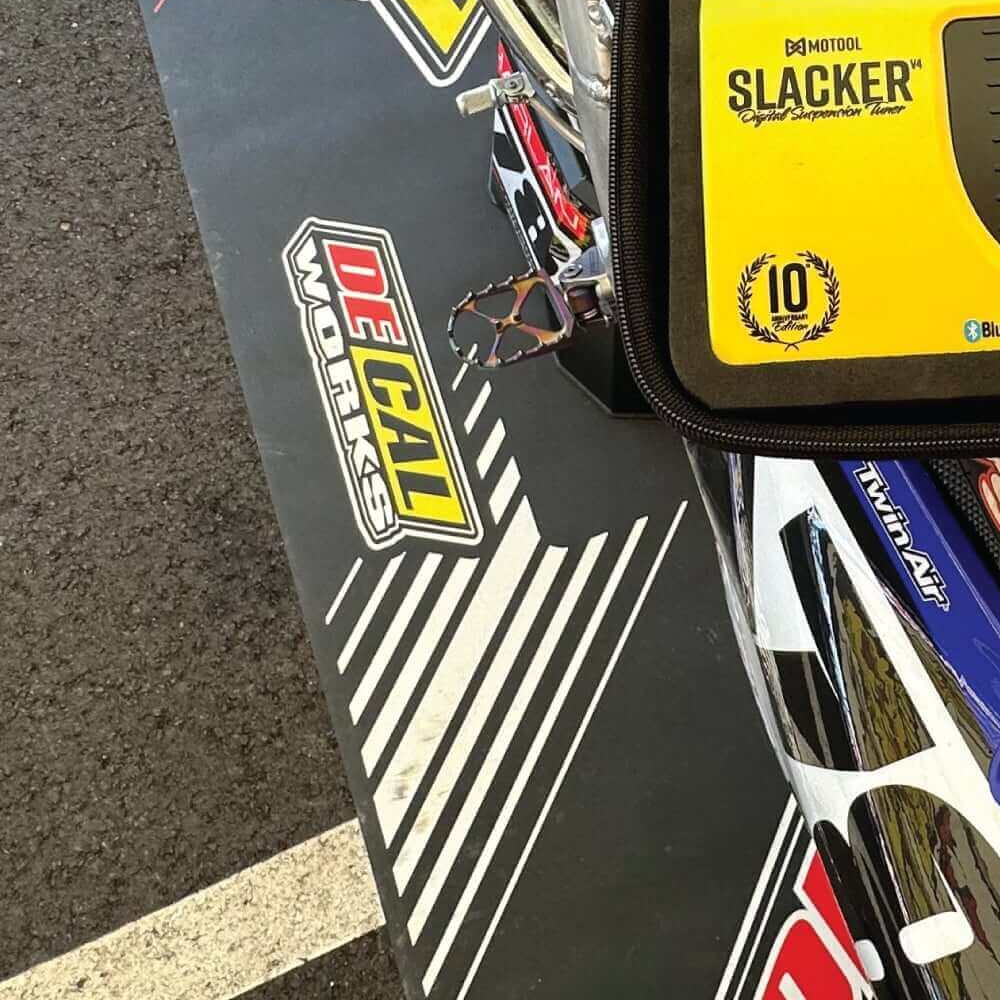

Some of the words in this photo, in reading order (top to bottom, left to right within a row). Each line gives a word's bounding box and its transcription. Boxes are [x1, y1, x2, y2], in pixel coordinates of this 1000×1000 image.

[808, 36, 863, 53] MOTOOL
[728, 60, 913, 112] SLACKER
[738, 107, 792, 128] Digital
[791, 106, 863, 123] Suspension
[864, 99, 907, 117] Tuner
[771, 319, 809, 331] Edition
[294, 236, 394, 533] WORKS
